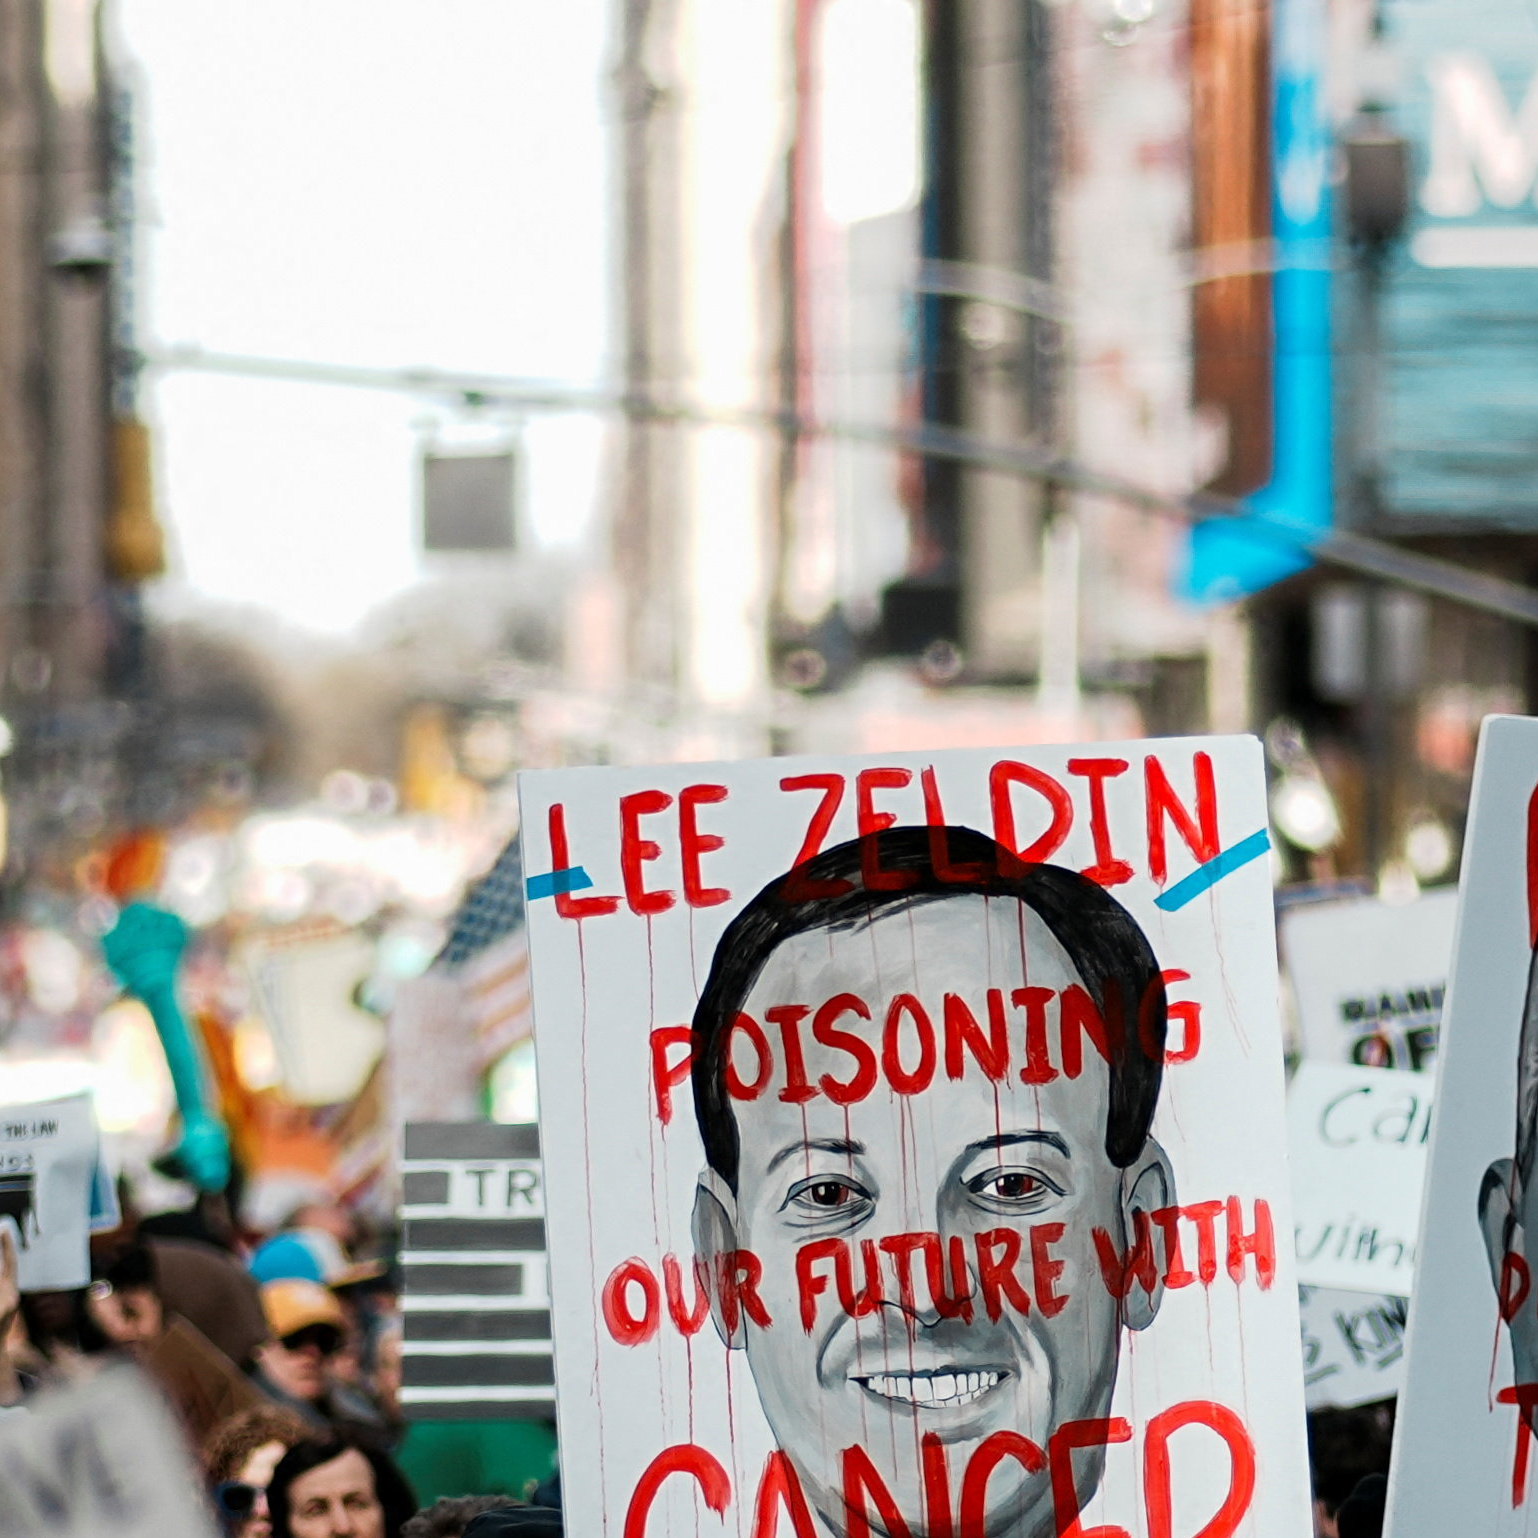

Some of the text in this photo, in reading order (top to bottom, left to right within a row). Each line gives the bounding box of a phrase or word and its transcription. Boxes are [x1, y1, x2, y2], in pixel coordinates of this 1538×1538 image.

[548, 750, 1222, 919] LEE ZELDIN
[649, 967, 1202, 1126] POISONING
[1319, 1086, 1434, 1150] Ca
[6, 1122, 27, 1137] THE
[602, 1195, 1276, 1347] OUR FUTURE WITH
